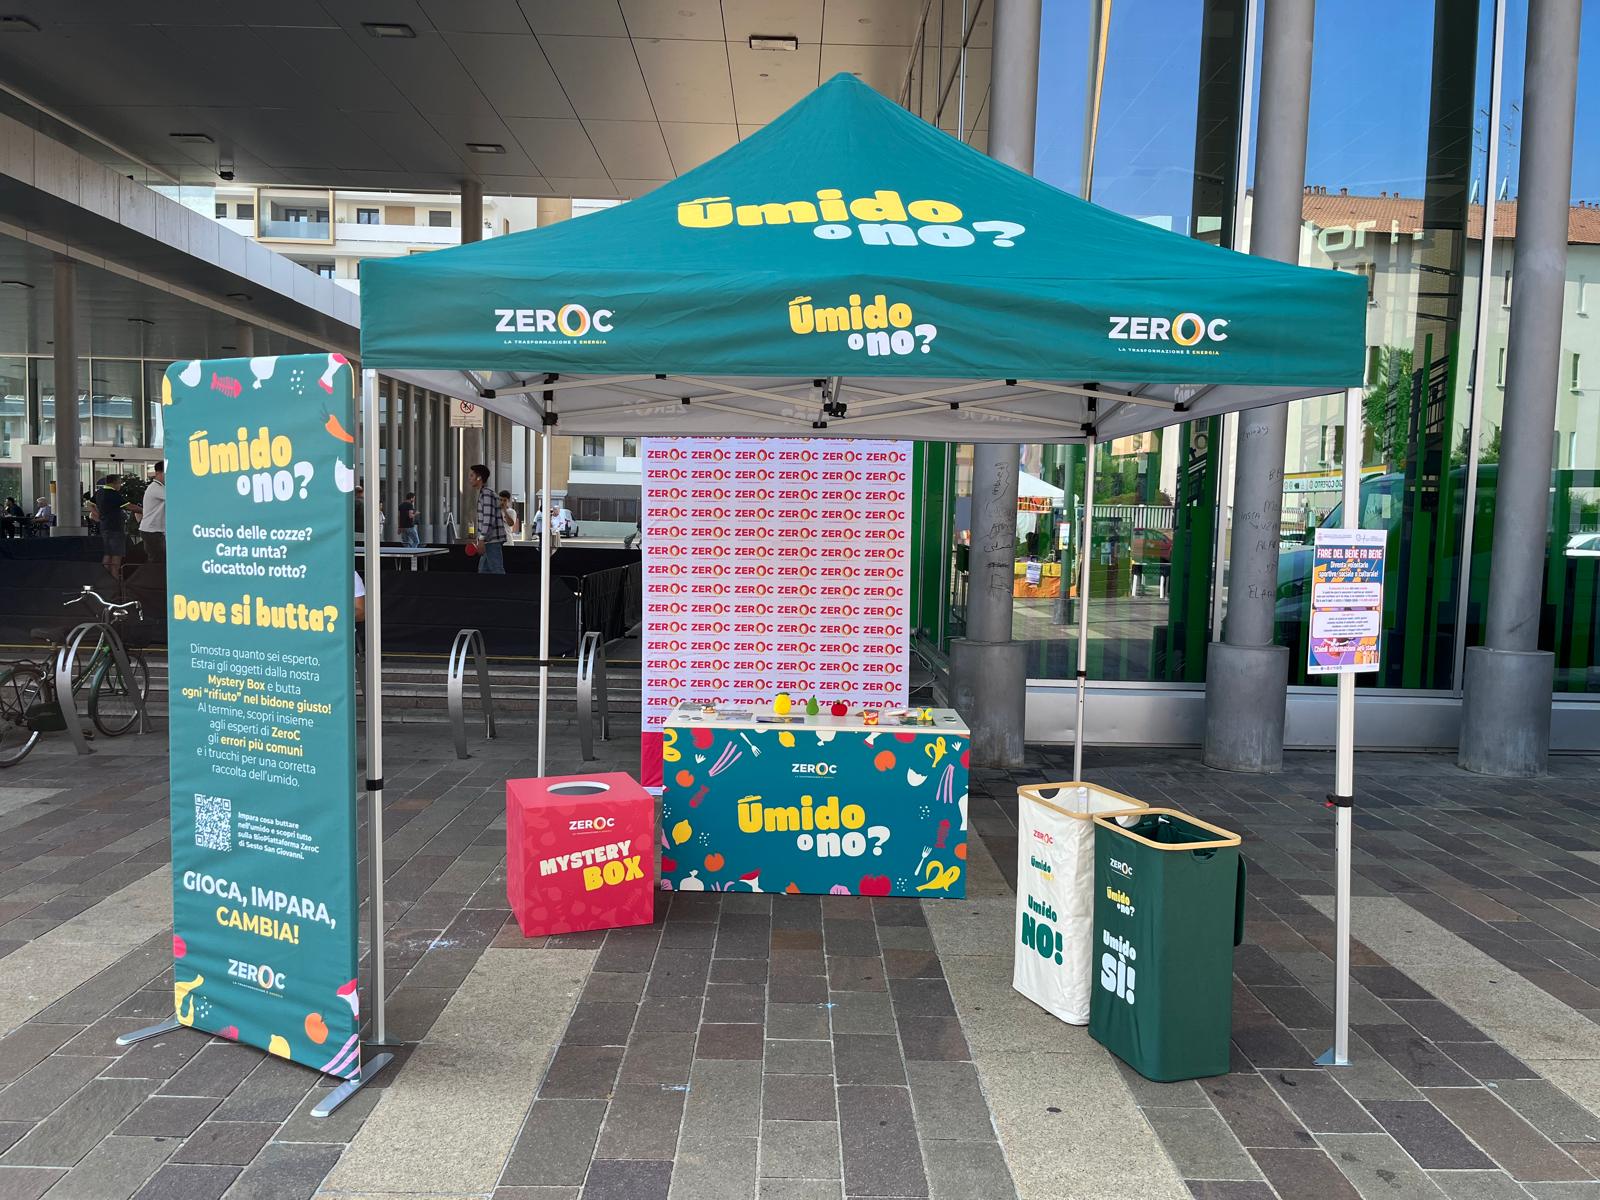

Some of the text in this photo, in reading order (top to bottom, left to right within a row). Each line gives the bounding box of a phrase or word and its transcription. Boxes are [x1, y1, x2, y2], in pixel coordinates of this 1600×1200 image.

[813, 220, 1026, 247] o no?
[495, 304, 615, 337] ZEROC
[1108, 312, 1231, 346] ZEROC
[847, 323, 937, 356] o no?
[648, 448, 907, 462] ZEROC ZEROC ZEROC ZEROC ZEROC ZEROC
[237, 461, 314, 503] o no?
[647, 467, 904, 482] ZEROC ZEROC ZEROC ZEROC ZEROC ZEROC
[647, 487, 904, 501] ZEROC ZEROC ZEROC ZEROC ZEROC ZEROC
[647, 506, 905, 521] ZEROC ZEROC ZEROC ZEROC ZEROC ZEROC
[192, 524, 313, 541] Guscio delle cozze?
[647, 525, 905, 540] ZEROC ZEROC ZEROC ZEROC ZEROC ZEROC
[216, 543, 287, 559] Carta unta?
[1317, 548, 1382, 559] FARE DEL BENE FA BENE
[202, 559, 306, 579] Giocattolo rotto?
[173, 594, 338, 633] Dove si butta?
[190, 643, 320, 667] Dimostra quanto sei esperto.
[191, 658, 319, 681] Estrai gli oggetti dalla nostra
[208, 674, 301, 694] Mystery Box e butta
[182, 687, 202, 698] ogni
[243, 694, 258, 704] nel
[261, 695, 294, 709] bidone
[297, 700, 332, 714] giusto!
[198, 702, 314, 727] Al termine, scopri insieme
[209, 720, 301, 740] agli esperti di ZeroC
[208, 734, 303, 757] gli errori più comuni
[197, 746, 316, 774] e i trucchi per una corretta
[792, 762, 837, 776] ZEROC
[212, 764, 247, 778] raccolta
[238, 812, 259, 821] Impara
[275, 819, 299, 829] buttare
[569, 817, 615, 830] ZEROC
[276, 830, 296, 838] scopri
[297, 833, 312, 842] tutto
[797, 825, 891, 858] o no?
[1033, 829, 1054, 845] ZEROC
[246, 841, 263, 850] Sesto
[264, 845, 275, 853] San
[276, 848, 304, 860] Giovanni.
[301, 843, 319, 853] ZeroC
[540, 840, 631, 876] MYSTERY
[583, 855, 644, 891] BOX
[1109, 858, 1133, 876] ZEROC
[183, 870, 337, 929] GIOCA, IMPARA,
[1027, 894, 1057, 923] Umido
[1120, 905, 1135, 917] no?
[216, 906, 299, 945] CAMBIA!
[1022, 912, 1063, 966] NO!
[1103, 929, 1136, 961] Umido
[227, 959, 285, 990] ZEROC
